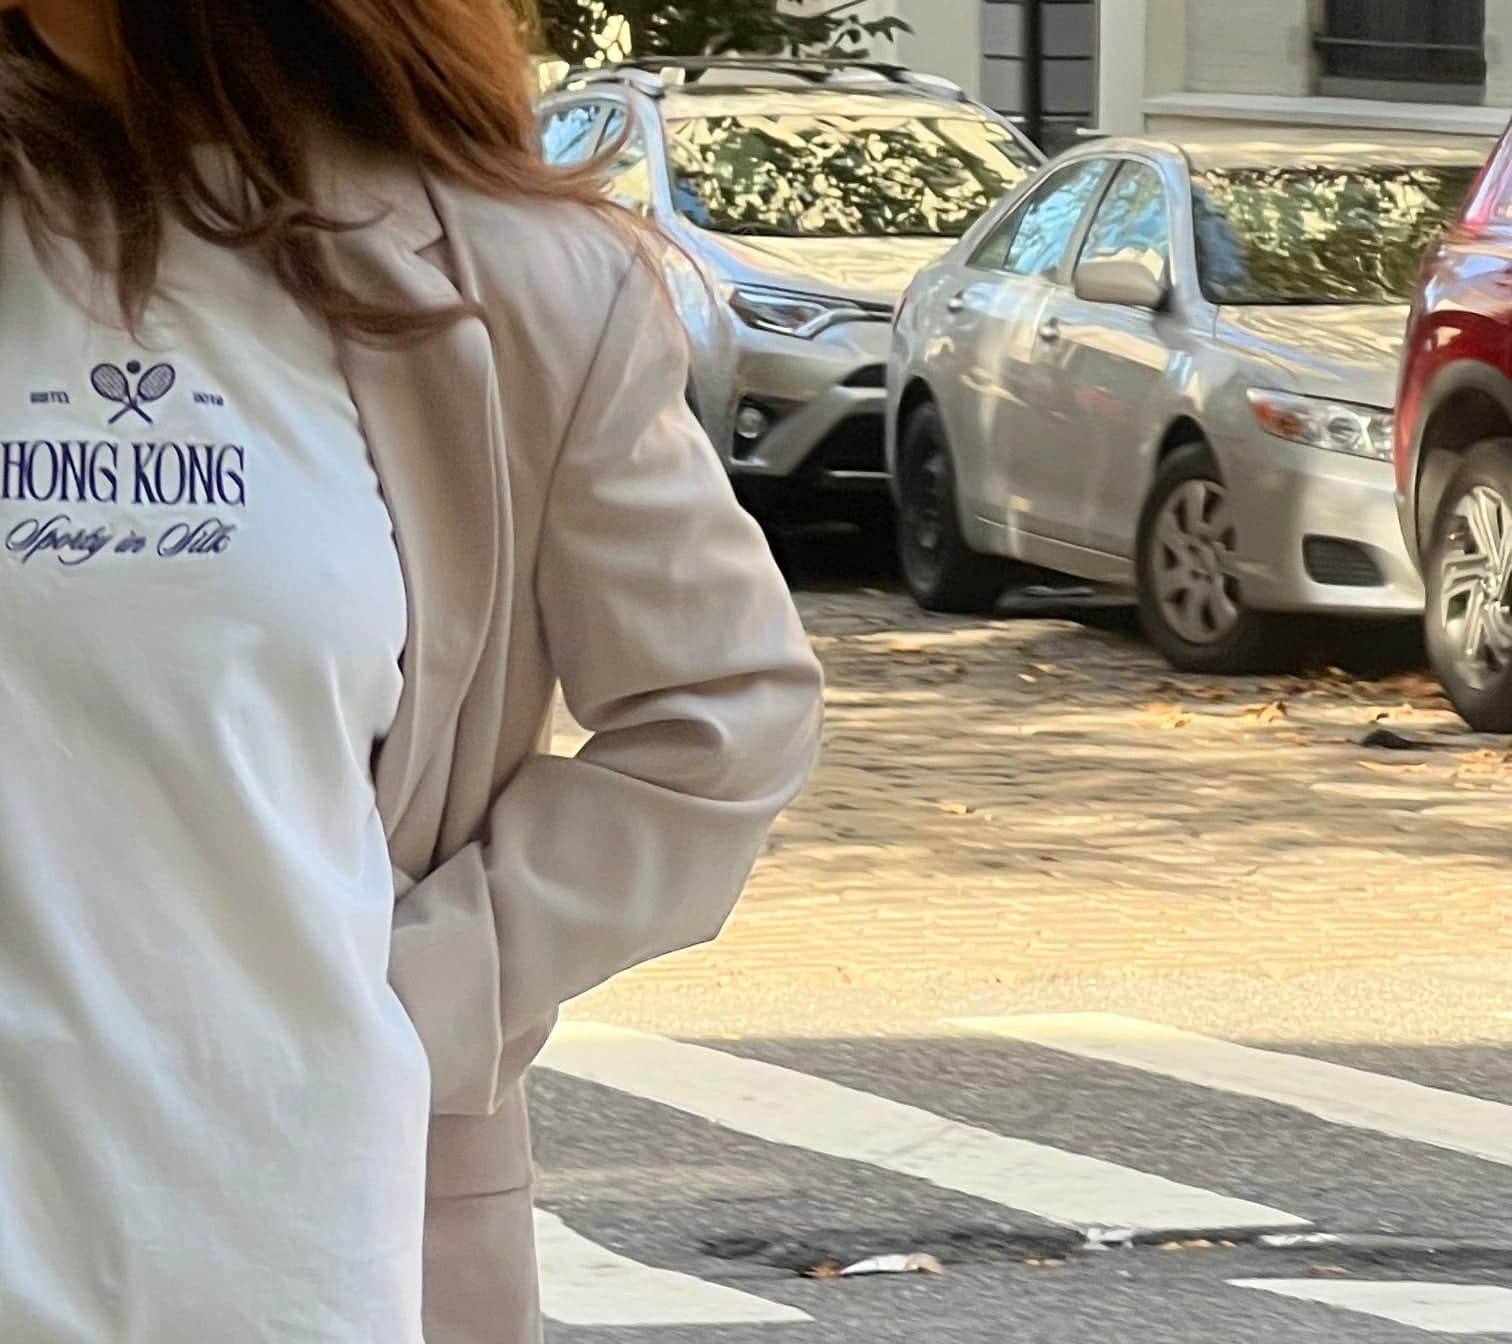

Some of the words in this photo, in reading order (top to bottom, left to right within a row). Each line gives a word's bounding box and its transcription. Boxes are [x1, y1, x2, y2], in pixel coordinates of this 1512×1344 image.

[0, 440, 119, 503] HONG
[131, 441, 246, 507] KONG
[5, 514, 114, 566] Sporty
[114, 530, 146, 554] in
[157, 517, 237, 558] Silk
